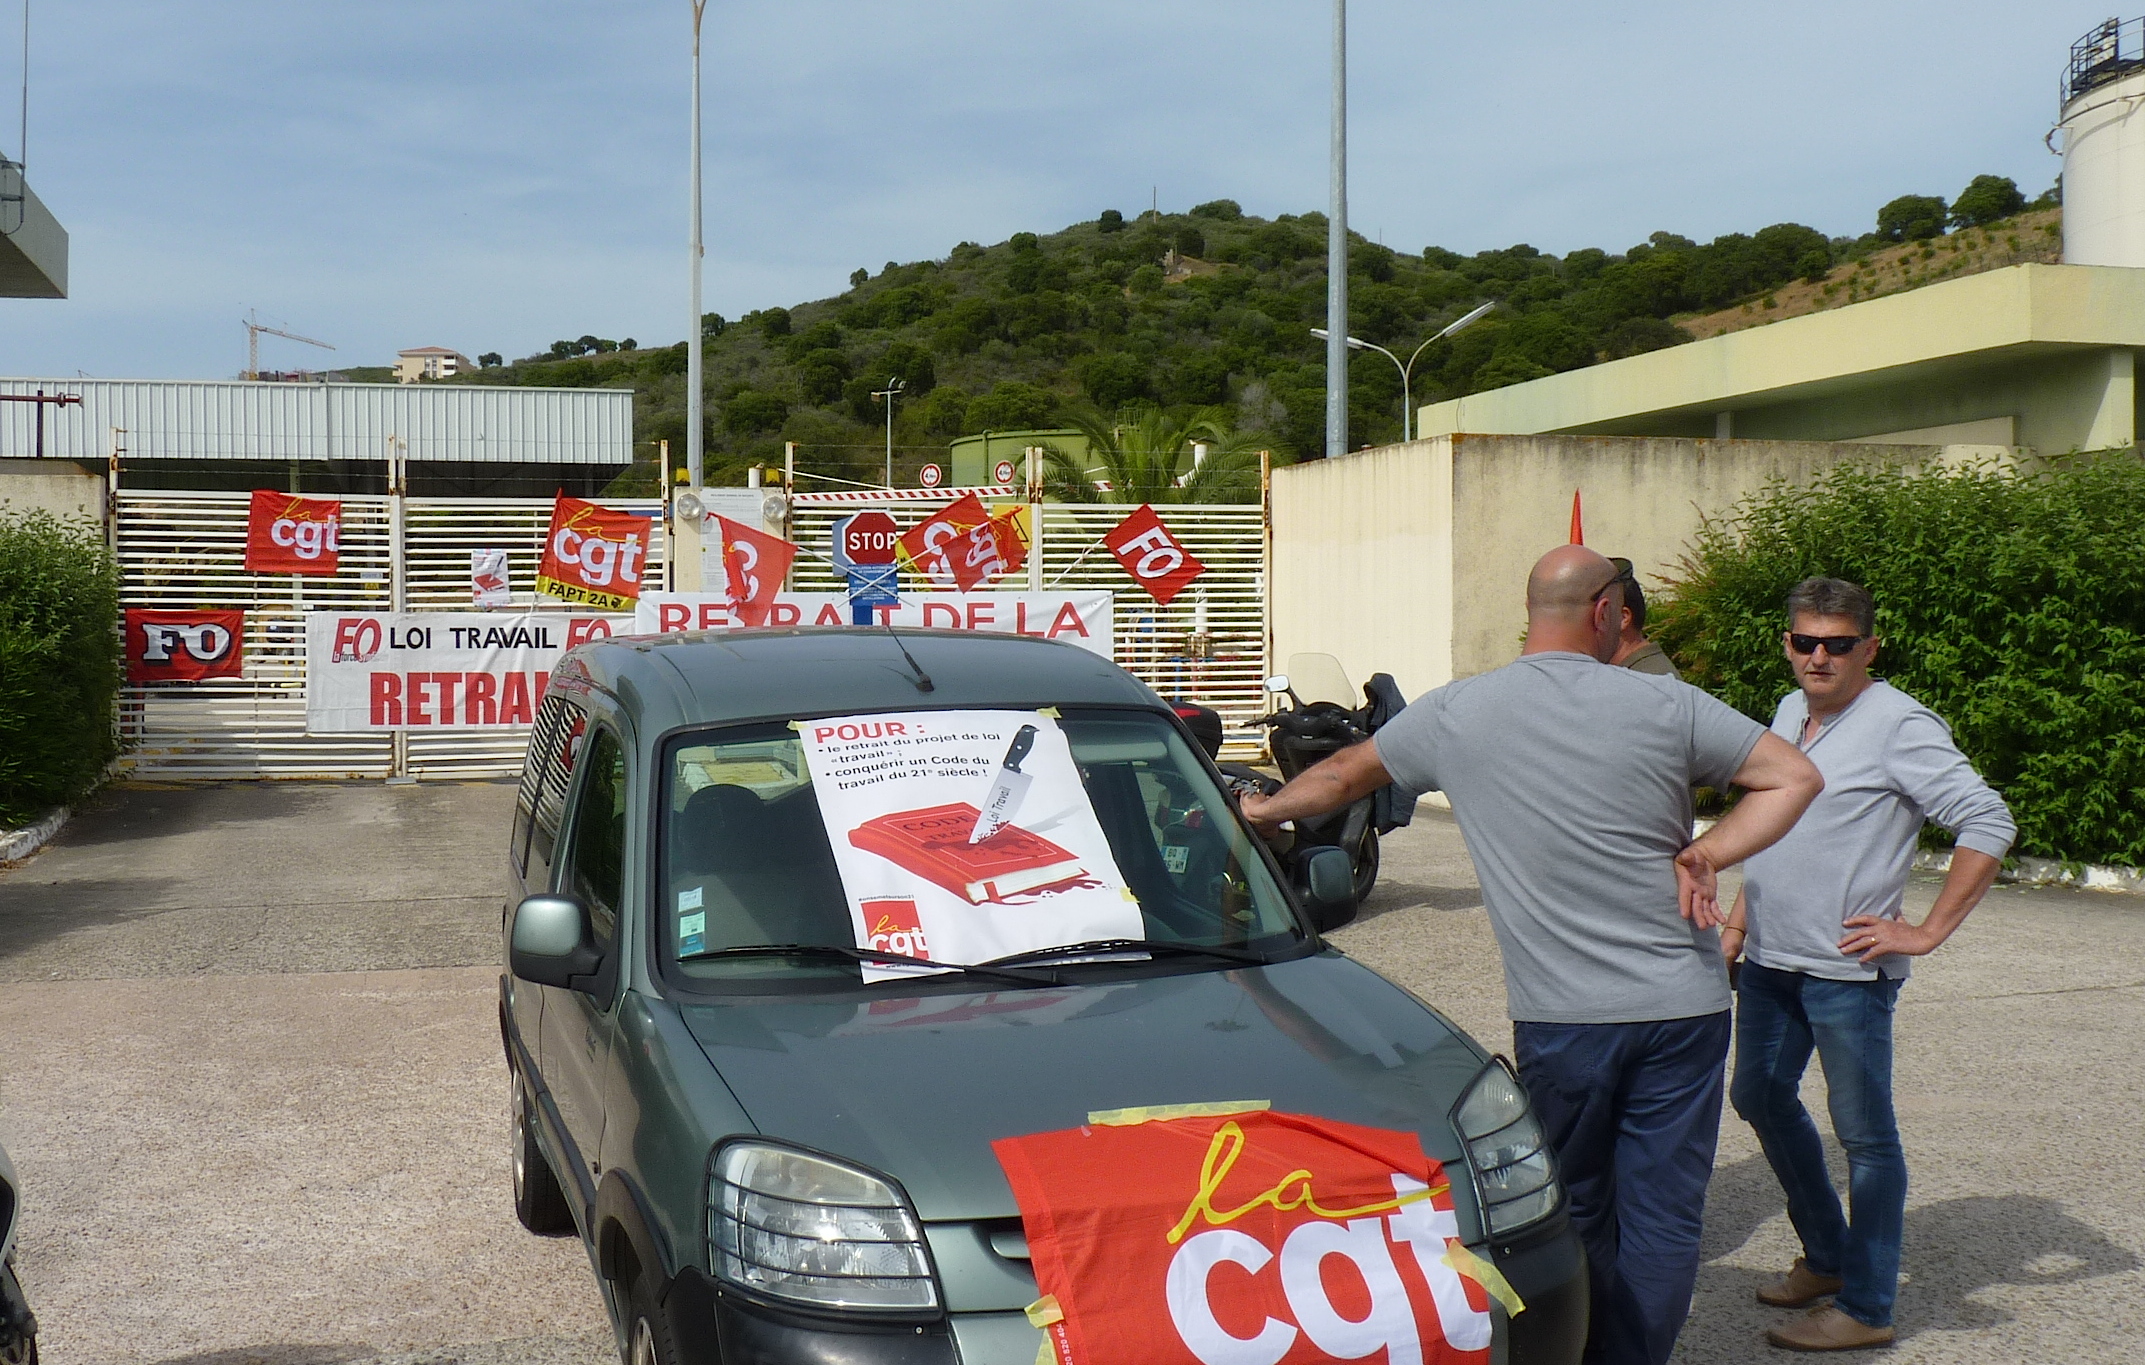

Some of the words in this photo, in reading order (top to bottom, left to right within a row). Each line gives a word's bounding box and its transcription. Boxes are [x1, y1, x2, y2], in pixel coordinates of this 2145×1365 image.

[271, 514, 339, 559] cgt
[849, 532, 897, 550] STOP
[553, 528, 642, 586] cgt
[1117, 525, 1183, 578] FO
[548, 582, 586, 601] FAPT
[588, 593, 608, 607] 2A
[660, 603, 901, 633] RERAT
[923, 602, 994, 630] DE
[1016, 601, 1089, 638] LA
[142, 623, 231, 662] FO
[332, 618, 382, 663] FO
[390, 627, 431, 649] LOI
[450, 627, 557, 649] TRAVAIL
[814, 721, 908, 744] POUR
[827, 745, 841, 754] le
[845, 739, 889, 752] retrait
[893, 738, 911, 746] du
[915, 733, 957, 746] projet
[961, 732, 979, 741] de
[835, 758, 904, 778] conquérir
[909, 758, 927, 766] un
[931, 755, 968, 765] Code
[972, 757, 990, 765] du
[838, 771, 885, 790] travail
[888, 771, 907, 781] du
[937, 768, 979, 777] siècle
[991, 785, 1011, 814] Travail
[903, 815, 973, 831] CODE
[987, 811, 1000, 823] Loi
[870, 914, 923, 936] la
[1167, 1120, 1451, 1245] la
[1165, 1172, 1493, 1365] cgt
